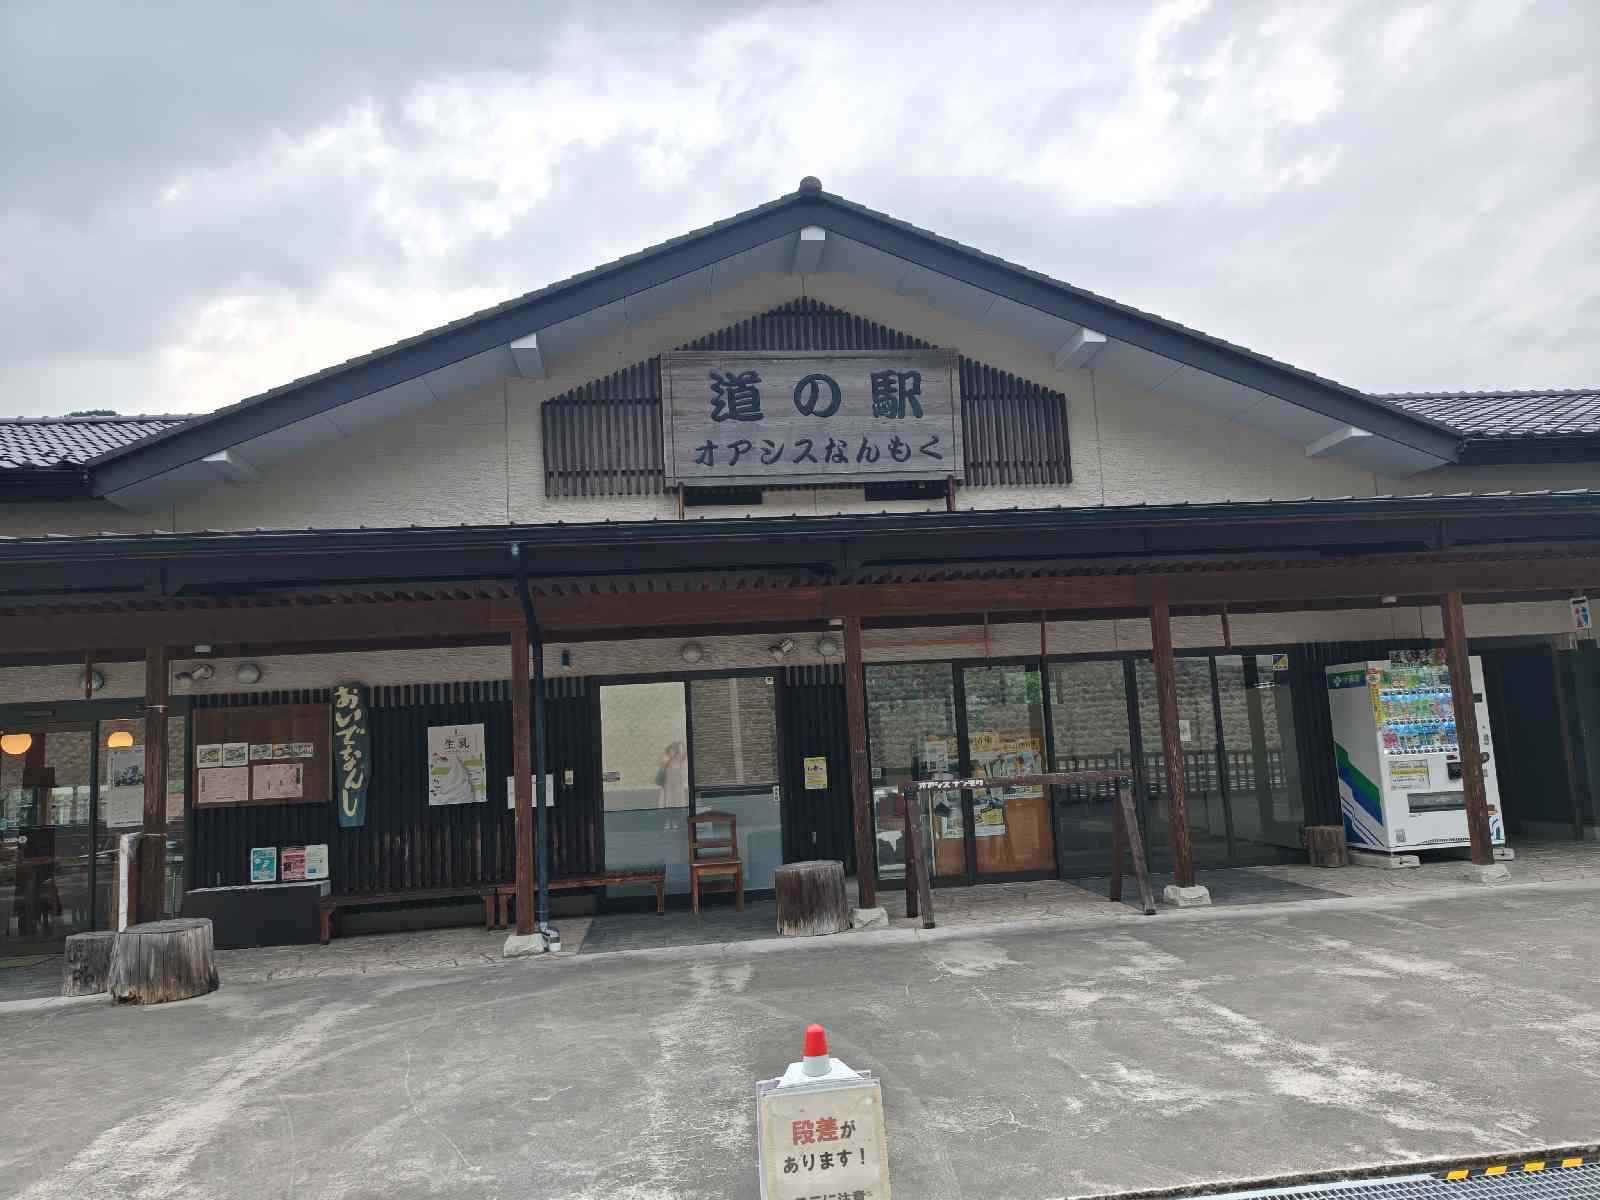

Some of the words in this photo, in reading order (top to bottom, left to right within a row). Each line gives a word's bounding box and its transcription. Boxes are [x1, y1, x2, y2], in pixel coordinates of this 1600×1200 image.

[709, 368, 924, 422] 道の駅
[695, 435, 943, 466] オアシスなんもく
[792, 1116, 857, 1146] 段差が
[783, 1148, 866, 1174] あります！
